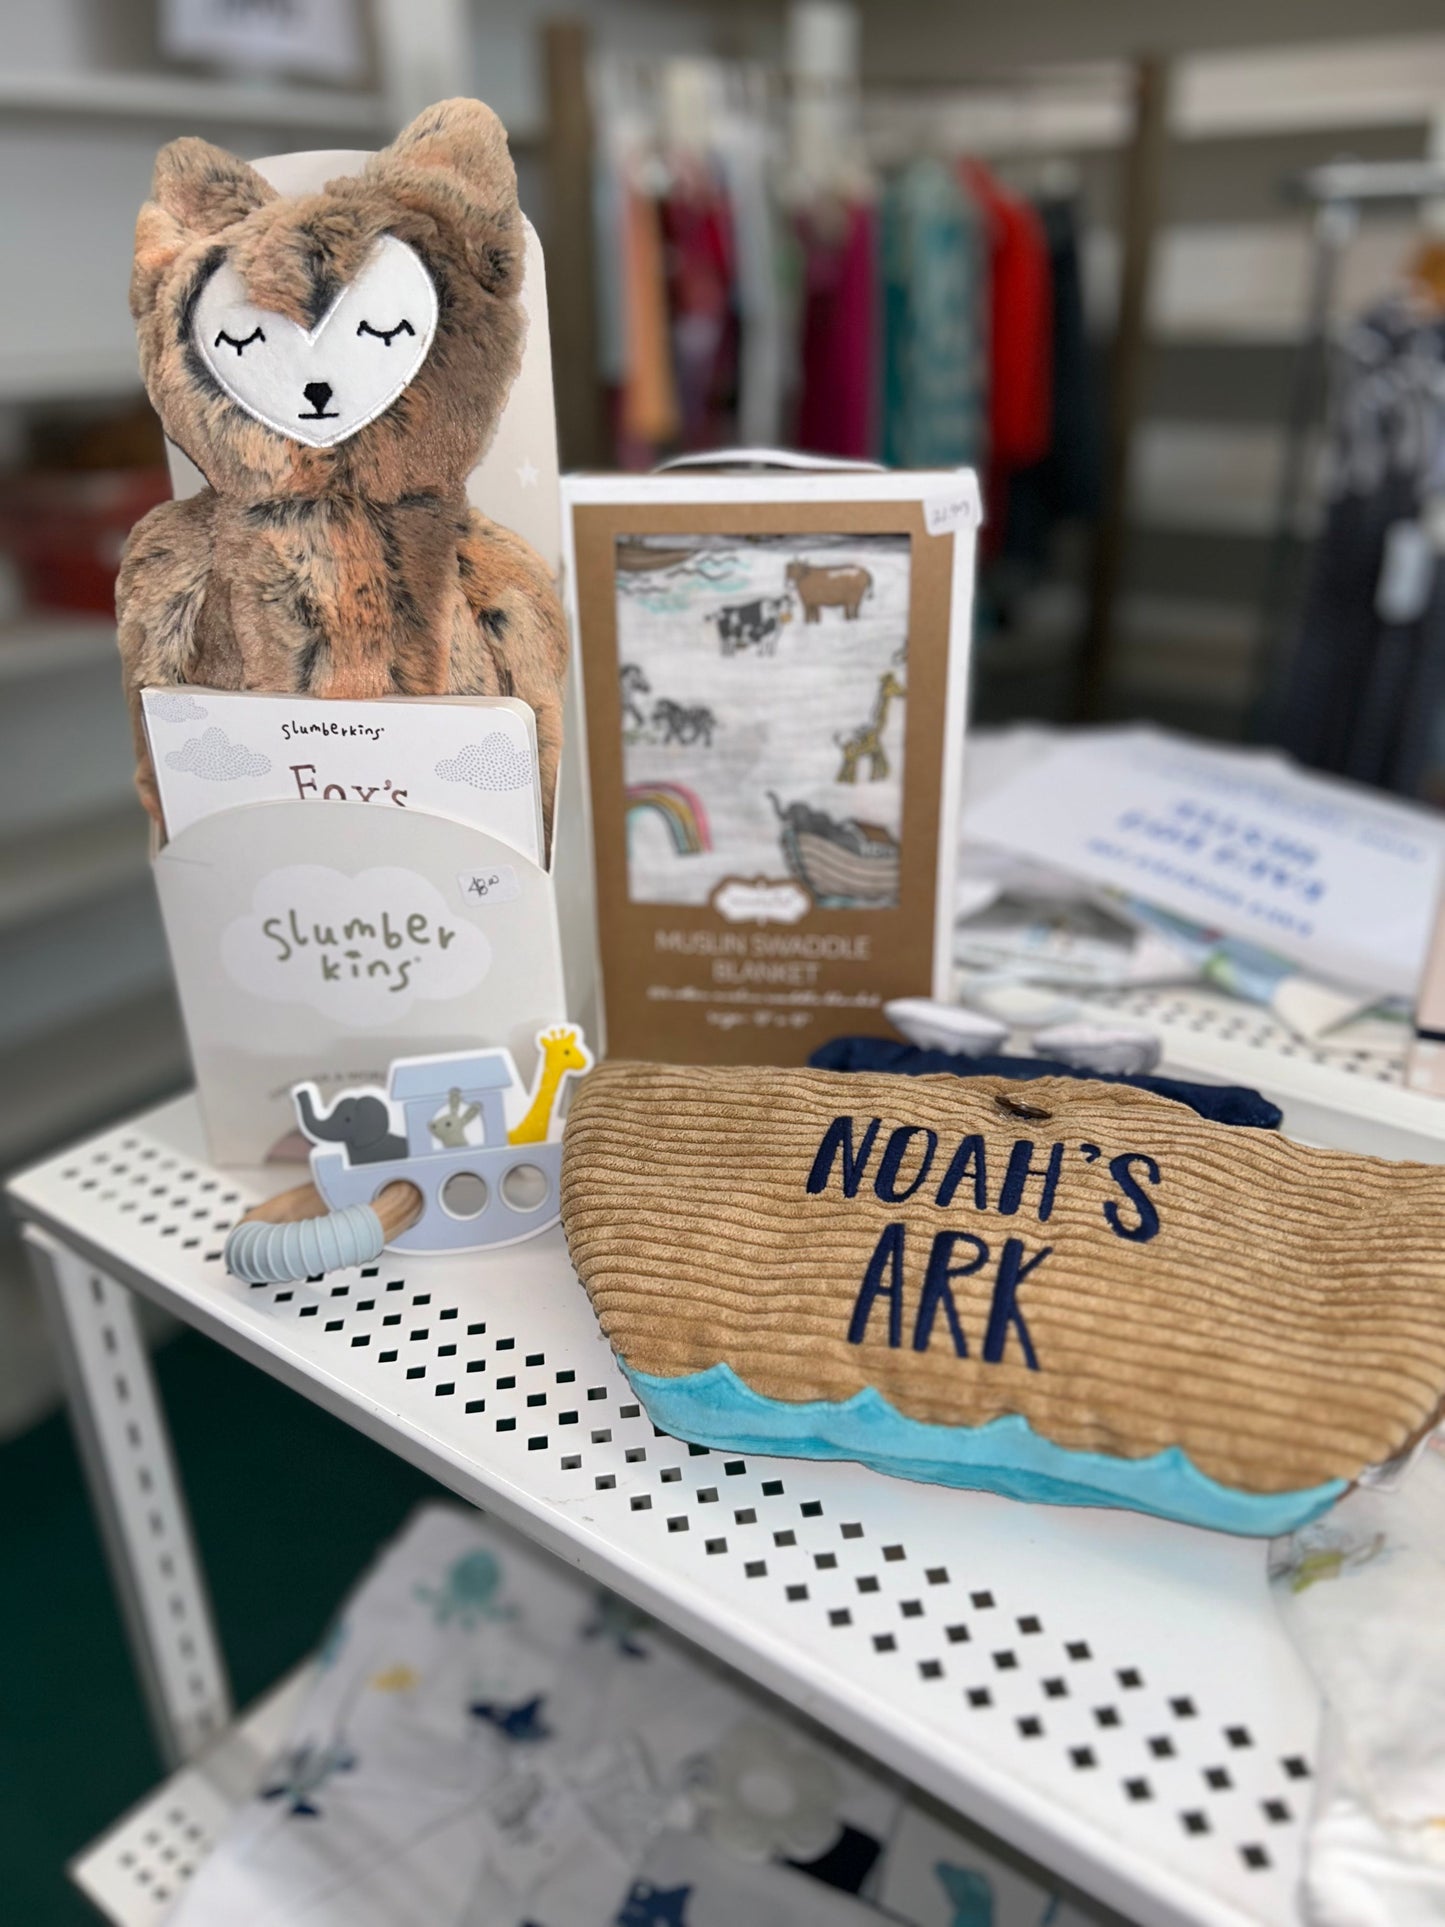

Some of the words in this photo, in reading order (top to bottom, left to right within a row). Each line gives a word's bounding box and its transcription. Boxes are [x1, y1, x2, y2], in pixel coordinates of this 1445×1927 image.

[263, 909, 456, 961] slumber
[711, 959, 821, 985] BLANKET
[806, 1115, 1160, 1243] NOAH'S
[847, 1222, 1053, 1371] ARK
